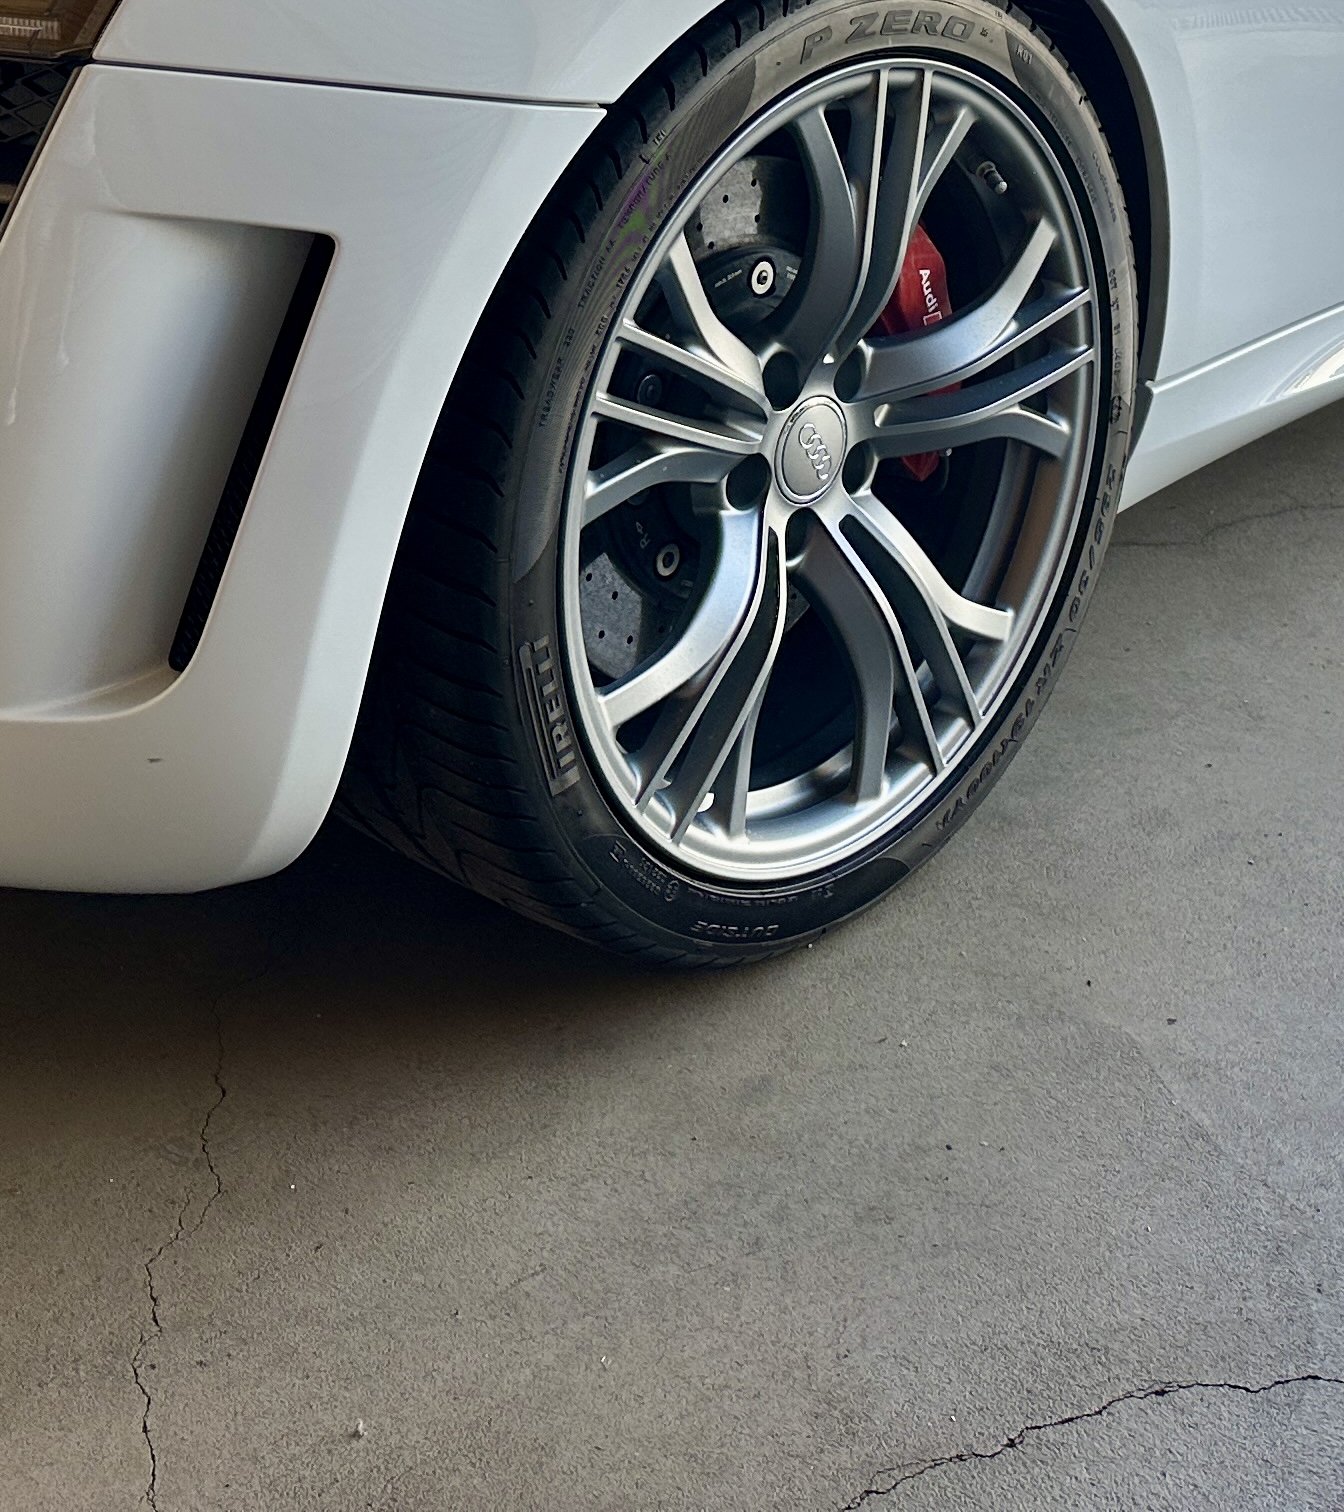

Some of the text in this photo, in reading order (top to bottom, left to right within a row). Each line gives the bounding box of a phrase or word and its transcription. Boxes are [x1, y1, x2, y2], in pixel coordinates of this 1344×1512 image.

[800, 9, 976, 65] P ZERO
[919, 269, 940, 313] Audi
[519, 634, 581, 798] PIRELLI
